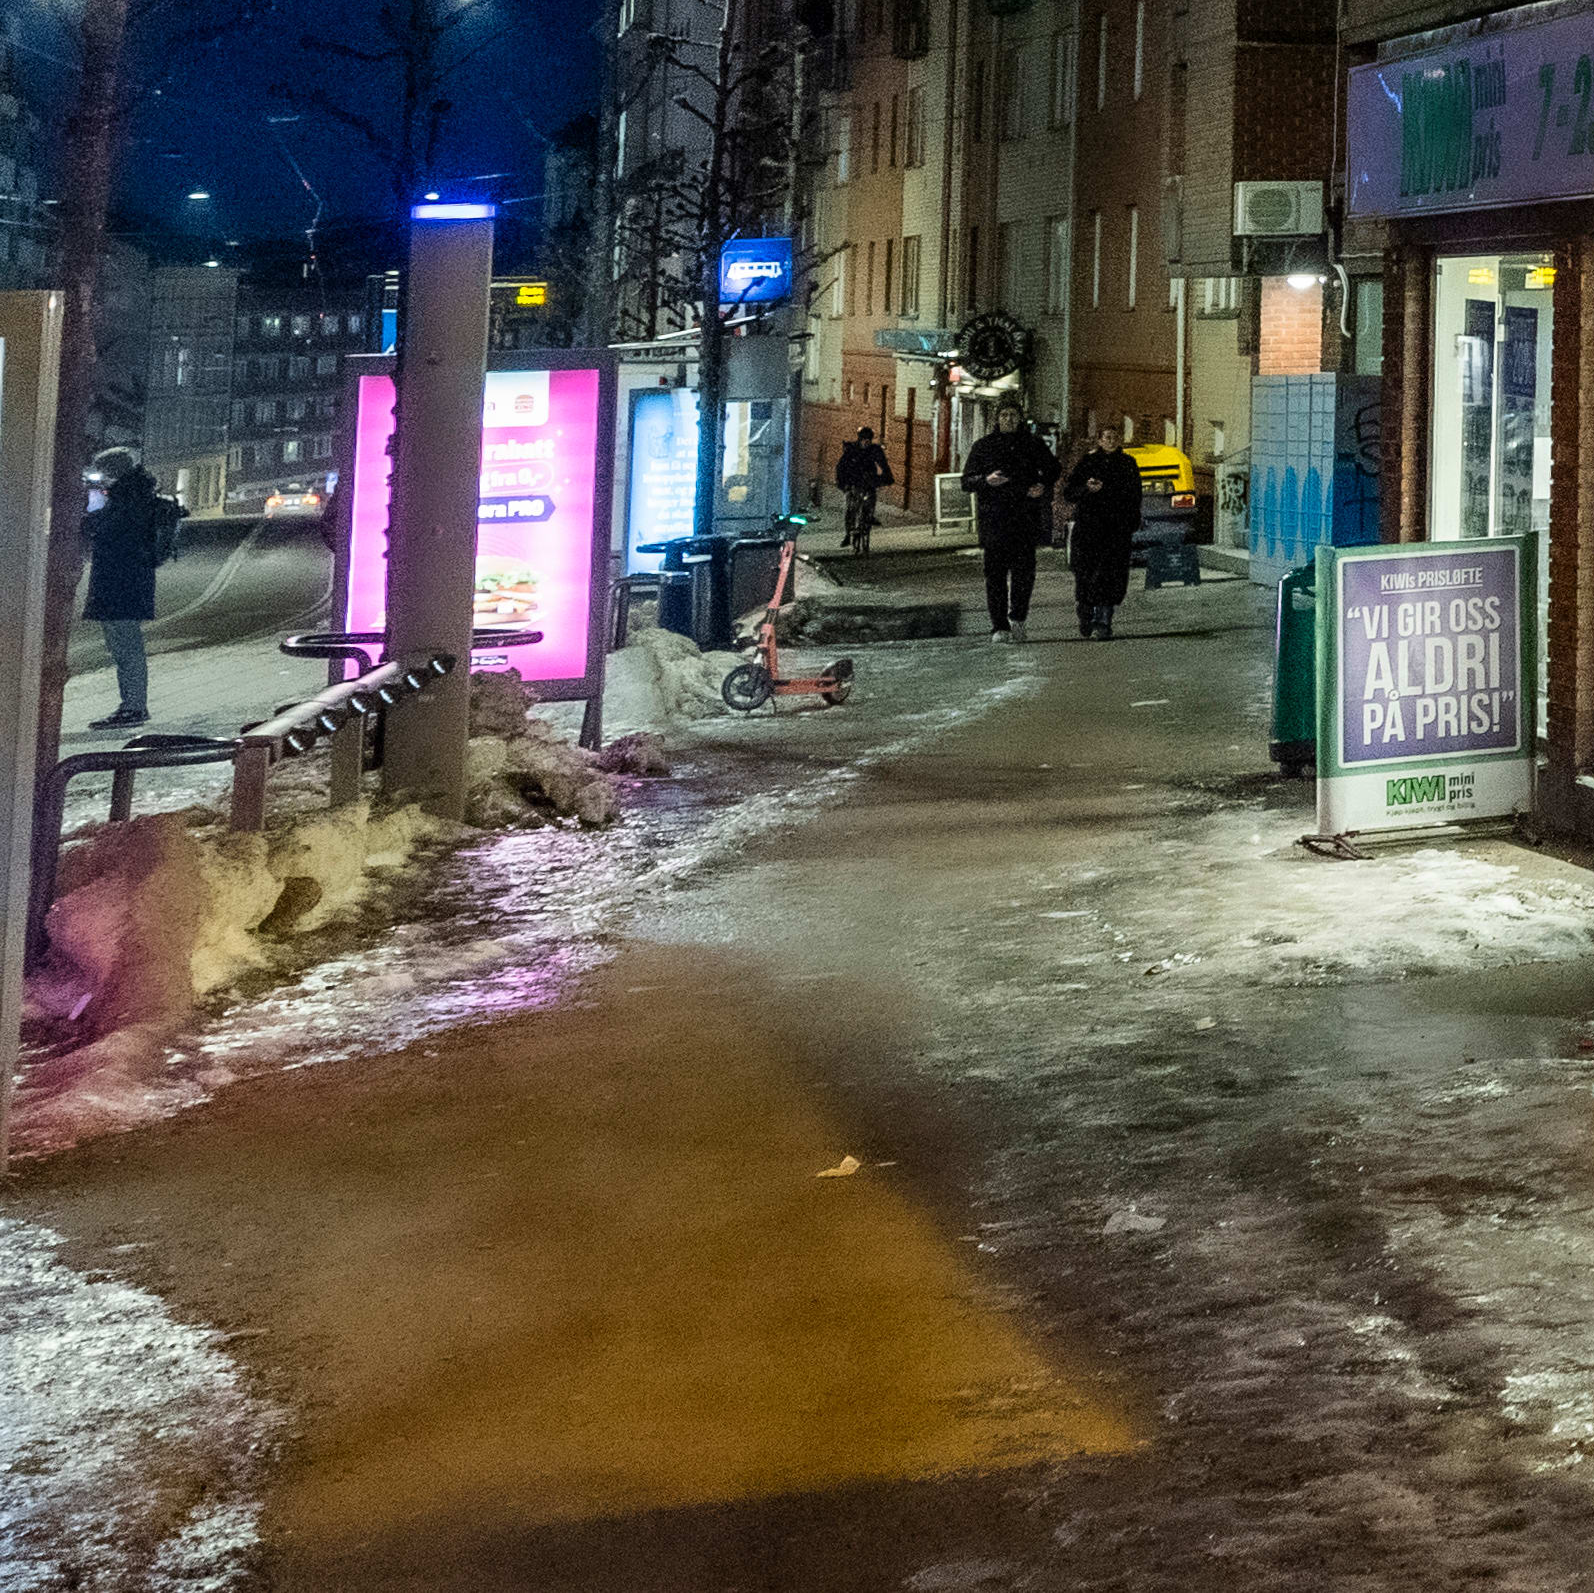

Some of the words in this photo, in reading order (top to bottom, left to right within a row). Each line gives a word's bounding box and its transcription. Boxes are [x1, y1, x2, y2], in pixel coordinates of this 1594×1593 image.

[1380, 572, 1416, 591] KIWIs
[1417, 567, 1484, 588] PRISLØFTE
[1397, 600, 1442, 637] GIR
[1449, 596, 1501, 633] OSS
[1363, 632, 1501, 701] ALDRI
[1363, 688, 1406, 746] PÅ
[1386, 774, 1446, 807] KIWI
[1449, 771, 1475, 787] mini
[1449, 784, 1474, 803] pris
